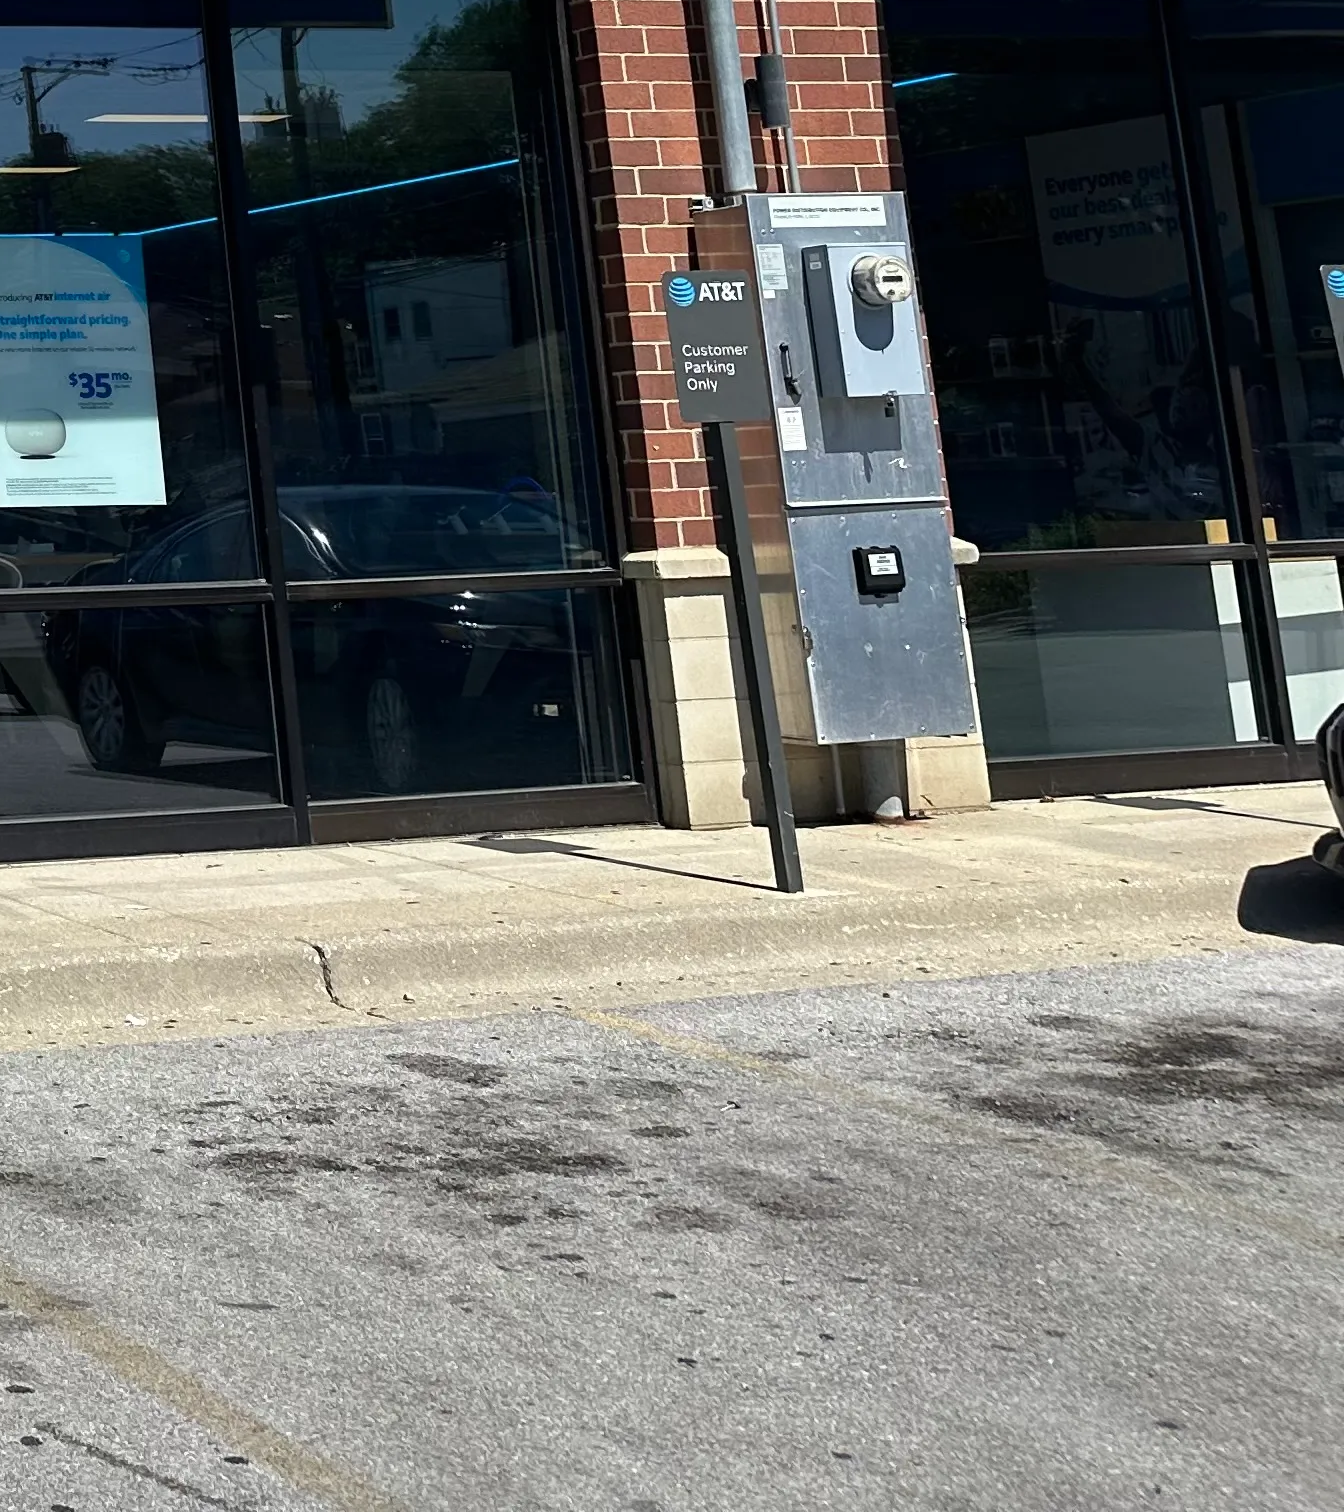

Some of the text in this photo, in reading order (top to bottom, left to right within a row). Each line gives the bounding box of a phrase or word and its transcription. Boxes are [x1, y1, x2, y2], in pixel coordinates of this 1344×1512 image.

[1044, 168, 1133, 197] Everyone
[1049, 202, 1080, 220] our
[1052, 225, 1105, 246] every
[34, 293, 53, 302] AT&T
[698, 281, 745, 302] AT&T
[89, 314, 131, 327] pricing.
[19, 329, 58, 342] simple
[59, 328, 88, 342] plan.
[682, 344, 749, 357] Customer
[684, 359, 736, 376] Parking
[68, 372, 133, 399] $35 mo.
[687, 377, 718, 393] Only
